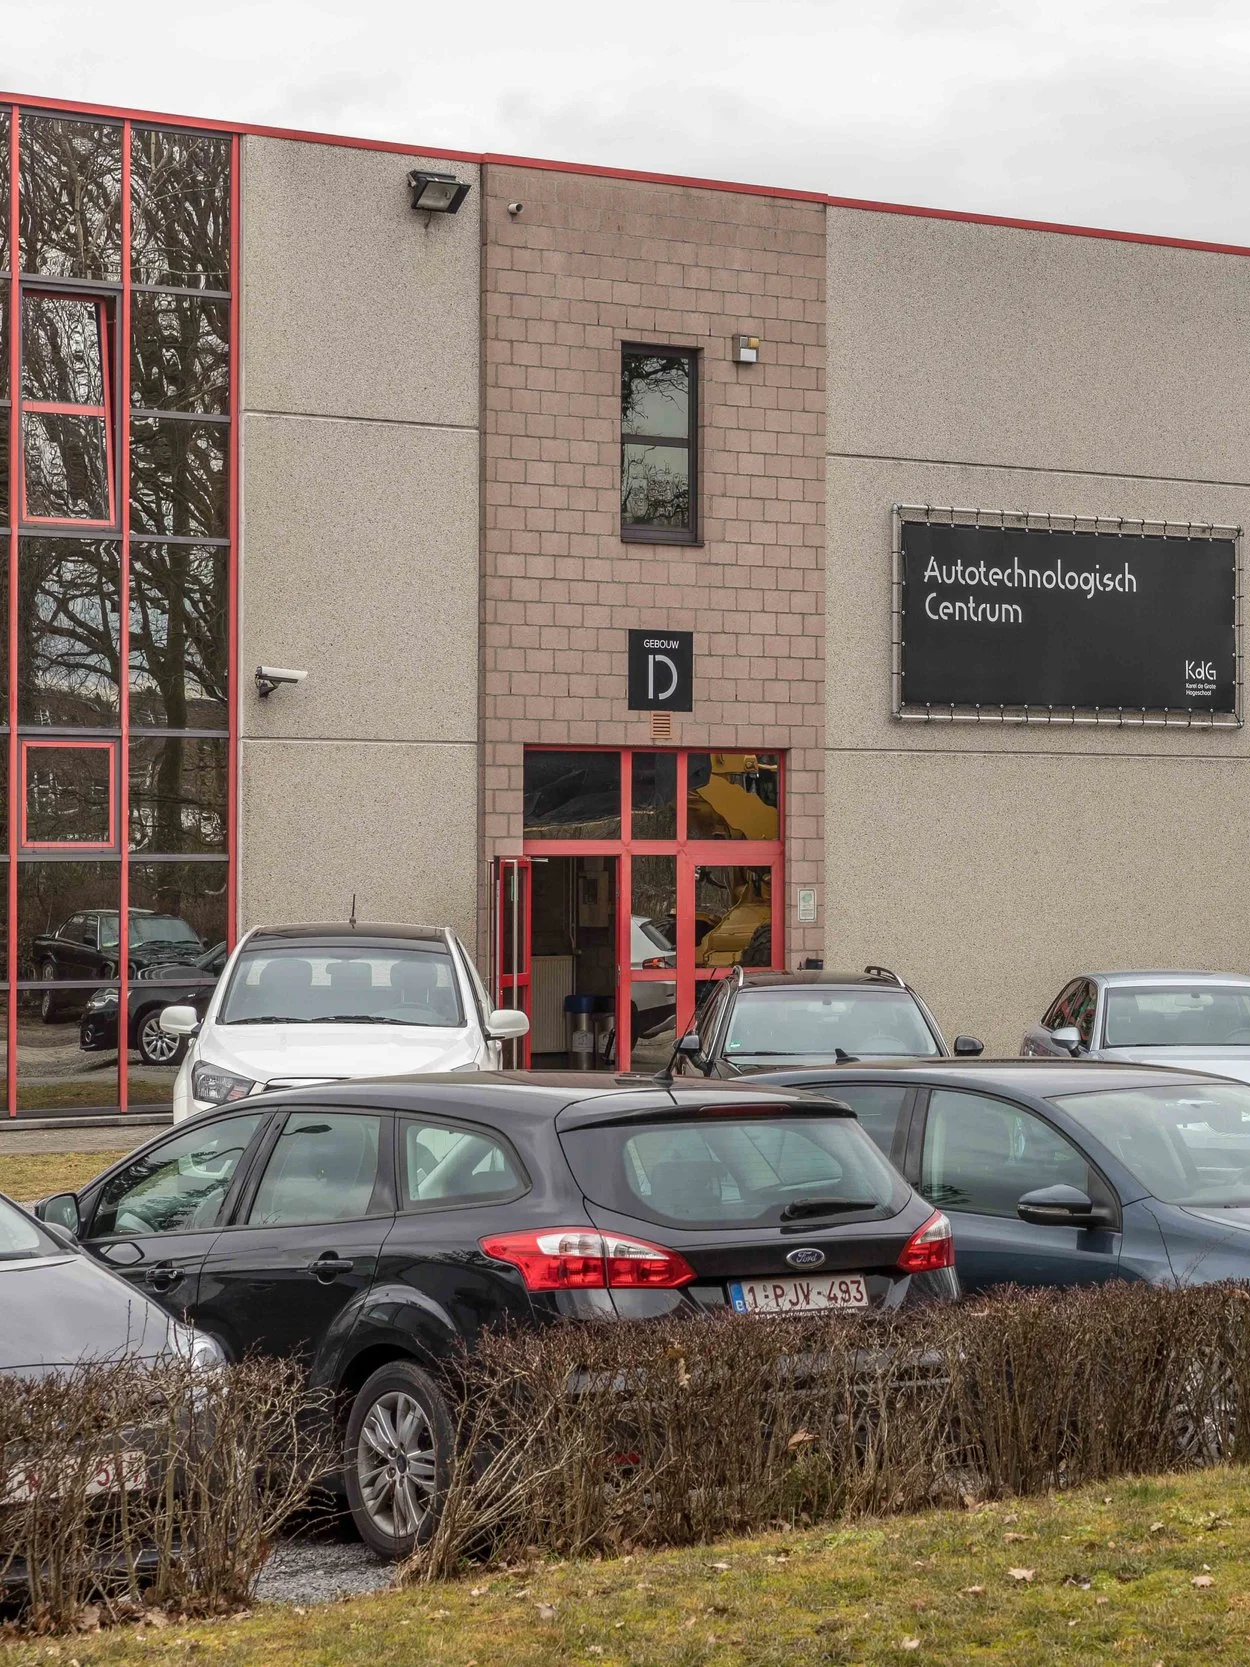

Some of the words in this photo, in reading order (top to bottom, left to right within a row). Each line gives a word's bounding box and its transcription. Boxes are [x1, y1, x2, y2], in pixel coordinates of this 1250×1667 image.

[924, 555, 1137, 599] Autotechnologisch
[925, 592, 1023, 623] Centrum
[643, 639, 680, 649] GEBOUW
[648, 654, 678, 700] D
[1185, 660, 1216, 680] KdG
[796, 1251, 818, 1264] Ford
[735, 1300, 744, 1311] B
